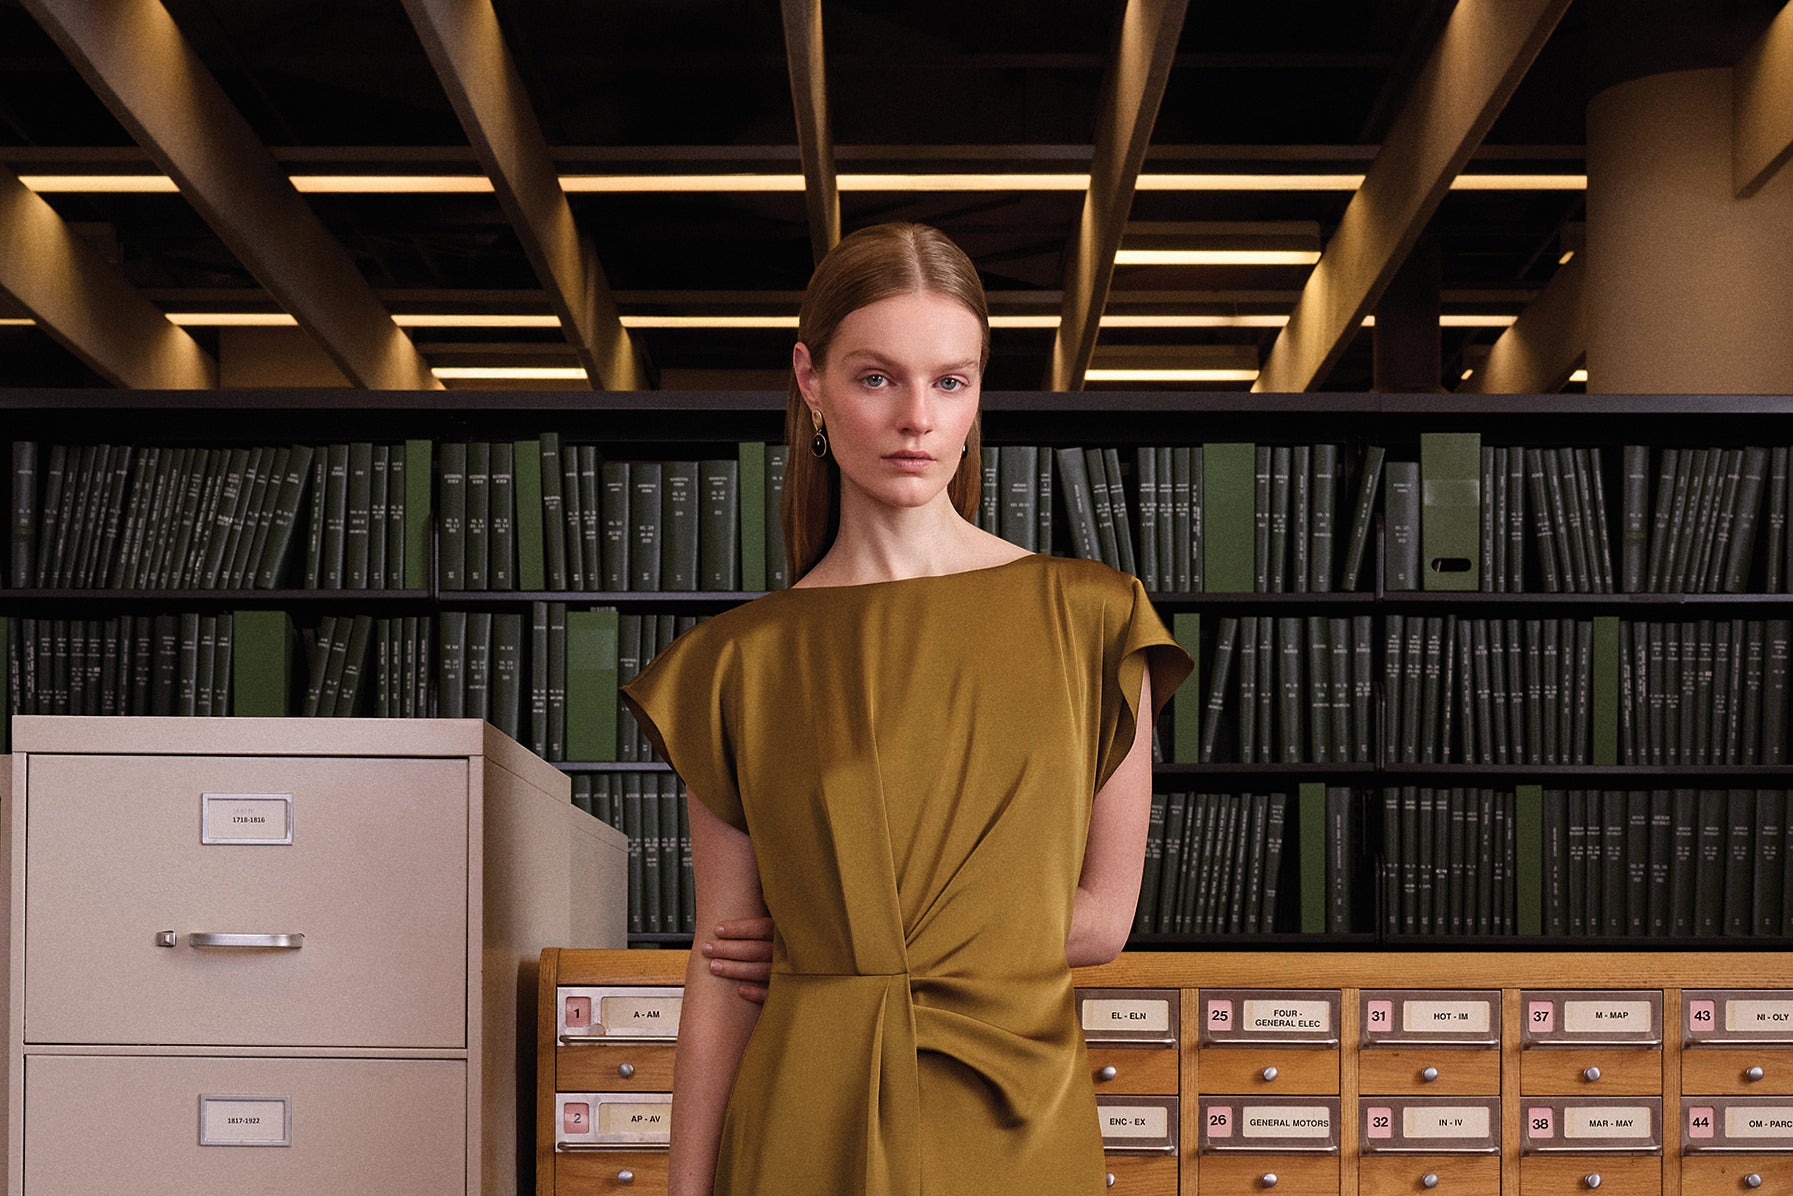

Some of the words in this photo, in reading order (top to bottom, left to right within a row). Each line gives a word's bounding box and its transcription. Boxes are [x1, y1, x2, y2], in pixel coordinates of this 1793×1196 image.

[232, 816, 266, 824] 1718-1816
[573, 1008, 580, 1019] 1
[633, 1011, 641, 1019] A
[646, 1010, 661, 1018] AM
[1111, 1011, 1123, 1020] EL
[1129, 1011, 1147, 1020] ELN
[1211, 1009, 1229, 1022] 25
[1273, 1009, 1298, 1018] FOUR
[1371, 1010, 1386, 1022] 31
[1433, 1012, 1452, 1021] HOT
[1458, 1012, 1469, 1021] IM
[1532, 1010, 1550, 1023] 37
[1595, 1011, 1603, 1019] M
[1609, 1011, 1629, 1019] MAP
[1693, 1010, 1711, 1022] 43
[1756, 1013, 1766, 1021] NI
[1772, 1013, 1790, 1022] OLY
[1254, 1018, 1296, 1028] GENERAL
[1297, 1019, 1321, 1028] ELEC
[573, 1112, 582, 1124] 2
[630, 1115, 643, 1123] AP
[649, 1115, 661, 1123] AV
[1109, 1117, 1128, 1126] ENC
[1134, 1118, 1146, 1126] EX
[1209, 1114, 1227, 1127] 26
[1372, 1116, 1389, 1128] 32
[1438, 1118, 1448, 1127] IN
[1454, 1118, 1463, 1127] IV
[1692, 1116, 1710, 1128] 44
[1249, 1118, 1291, 1127] GENERAL
[1292, 1119, 1330, 1128] MOTORS
[1532, 1118, 1549, 1130] 38
[1589, 1119, 1609, 1128] MAR
[1615, 1119, 1634, 1127] MAY
[1748, 1119, 1763, 1128] OM
[1769, 1120, 1793, 1128] PARC
